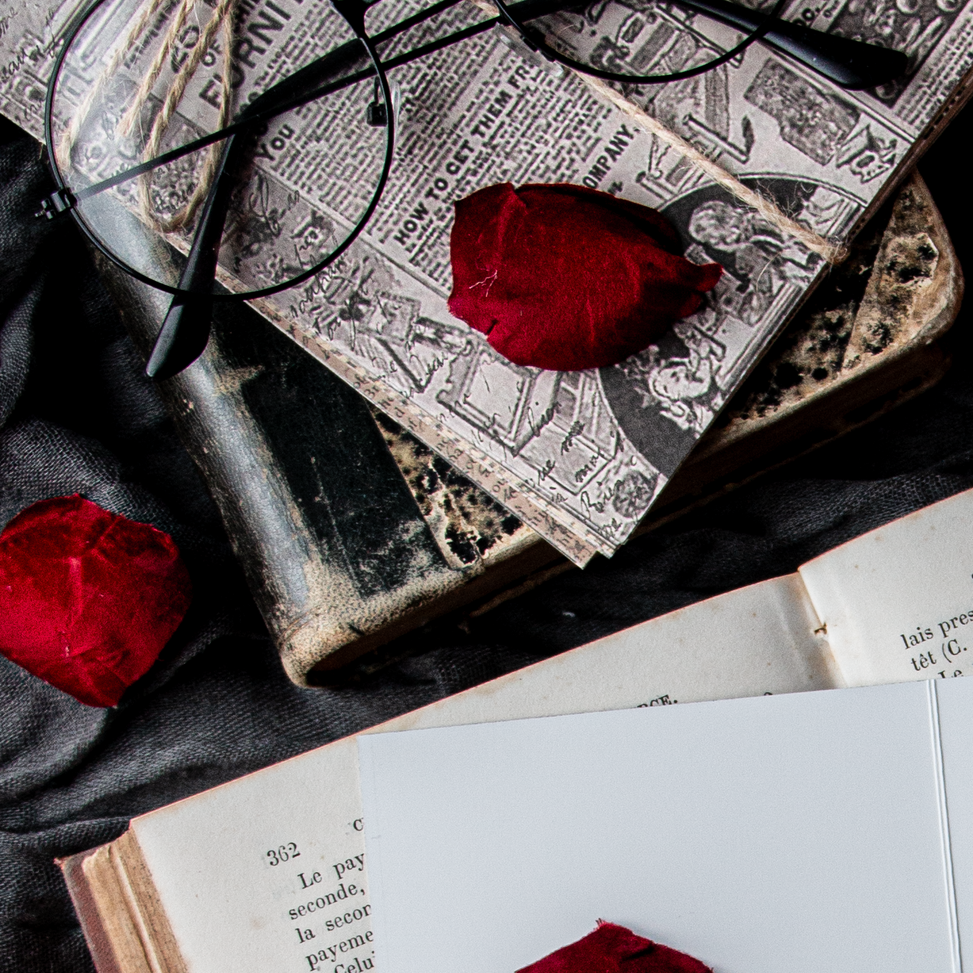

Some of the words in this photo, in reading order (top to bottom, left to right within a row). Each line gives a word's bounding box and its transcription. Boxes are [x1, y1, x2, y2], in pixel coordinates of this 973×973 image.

[199, 0, 294, 109] FURNI
[255, 123, 295, 162] You
[582, 125, 640, 191] OMPANY,
[396, 203, 434, 247] HOW
[425, 176, 450, 204] TO
[446, 138, 479, 178] GET
[471, 89, 515, 142] THEM
[900, 627, 934, 649] lais
[911, 651, 937, 671] têt
[267, 842, 301, 866] 362
[297, 872, 322, 889] Le
[333, 853, 364, 880] pay
[289, 883, 365, 920] seconde,
[295, 928, 316, 943] la
[305, 931, 373, 971] payeme
